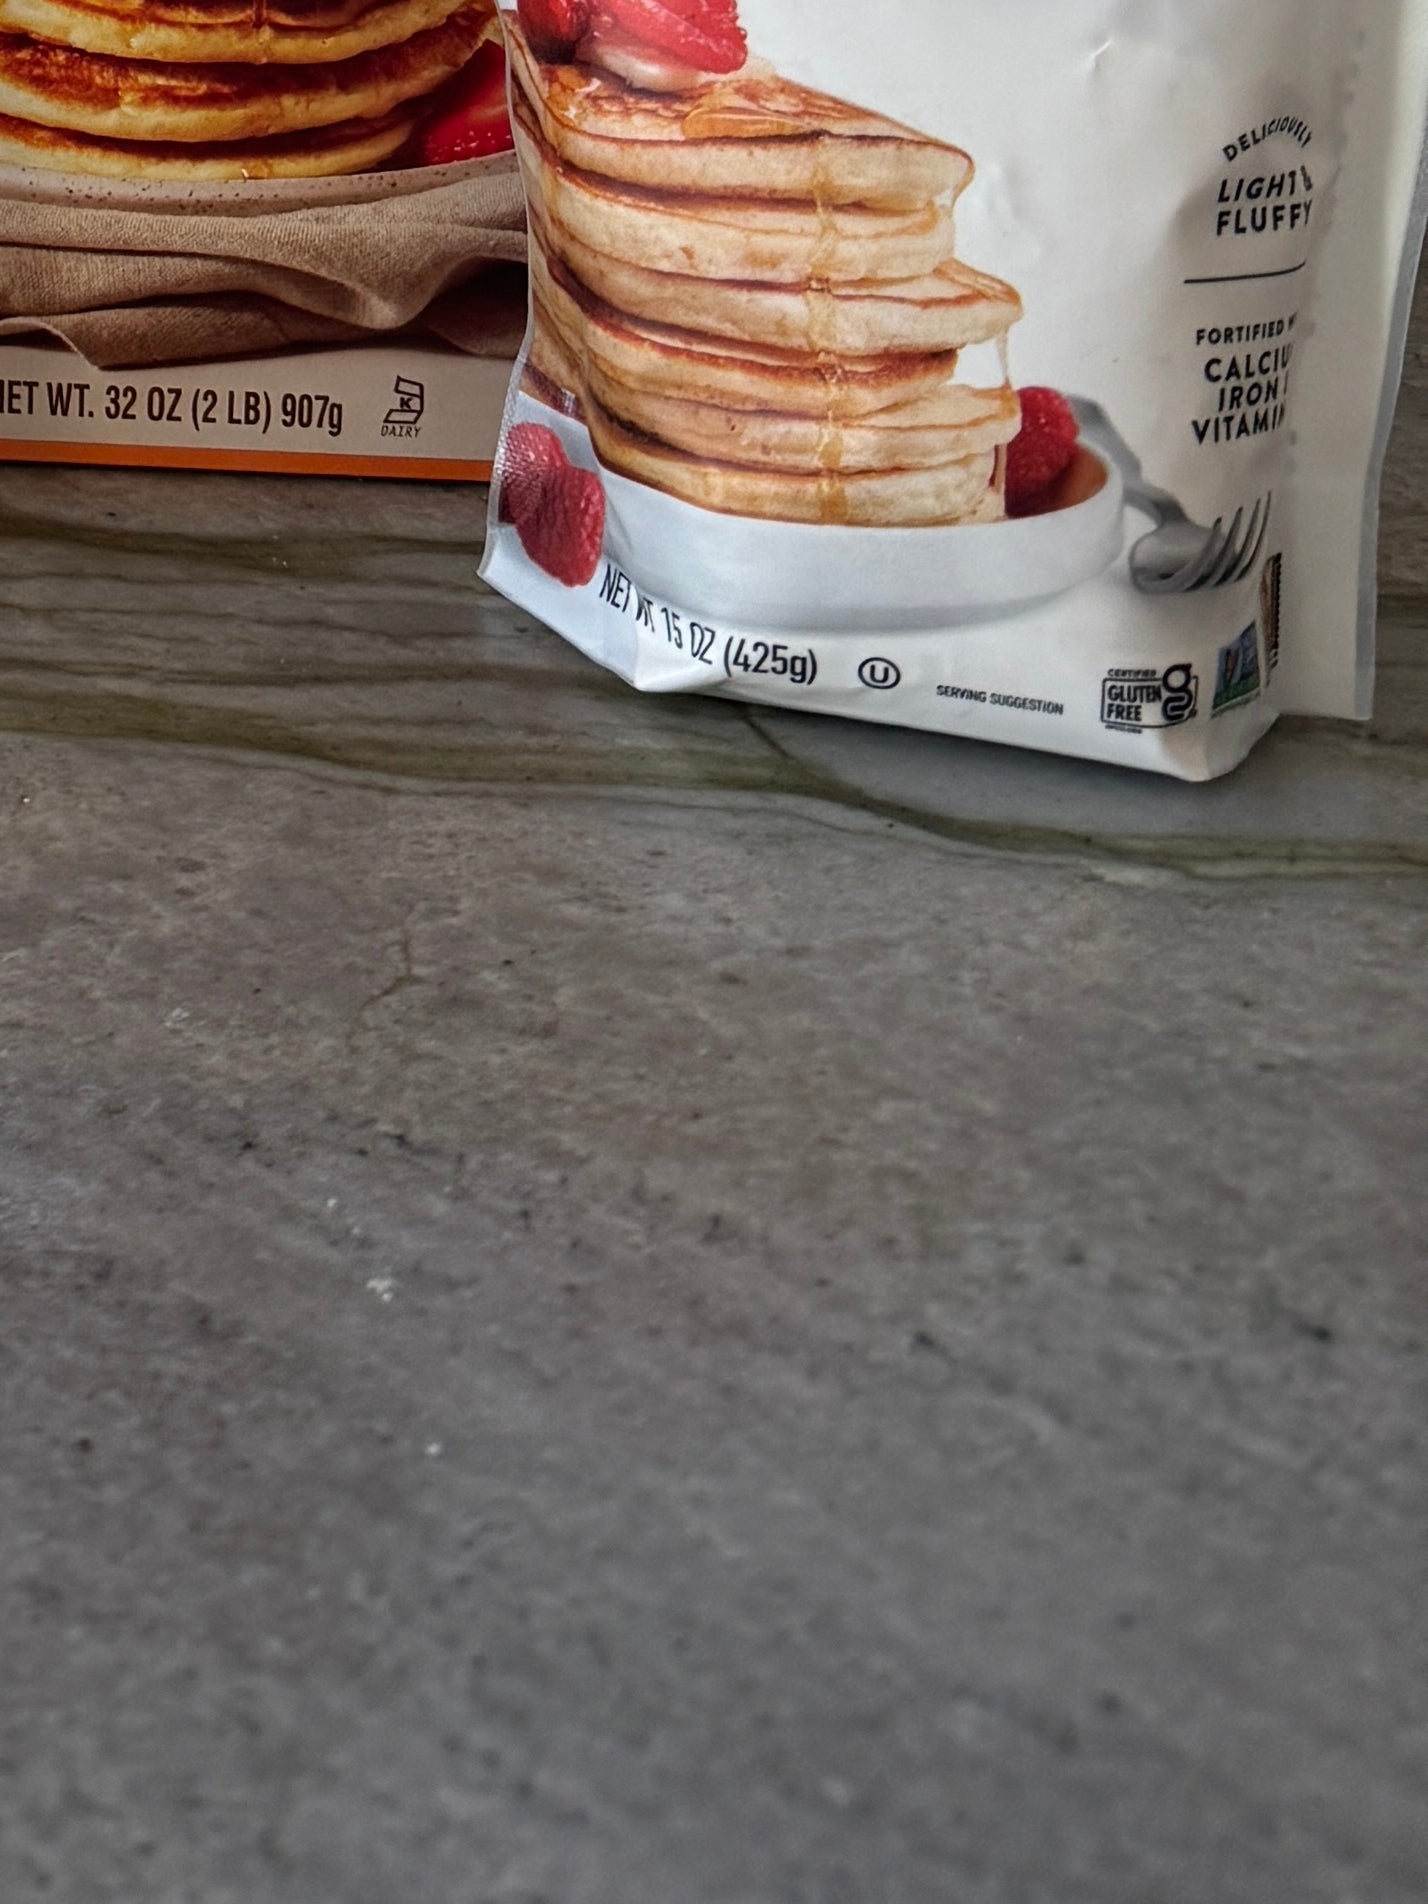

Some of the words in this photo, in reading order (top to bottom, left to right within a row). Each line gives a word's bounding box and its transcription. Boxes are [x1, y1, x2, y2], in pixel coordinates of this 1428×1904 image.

[1222, 116, 1313, 162] DELICIOUSLY
[1217, 171, 1297, 203] LIGHT
[1216, 199, 1312, 236] FLUFFY
[1196, 319, 1284, 345] FORTIFIED
[46, 382, 95, 418] WT.
[104, 385, 139, 420] 32
[146, 387, 183, 424] OZ
[190, 387, 219, 430] (2
[226, 389, 273, 430] LB)
[280, 391, 343, 436] 907g
